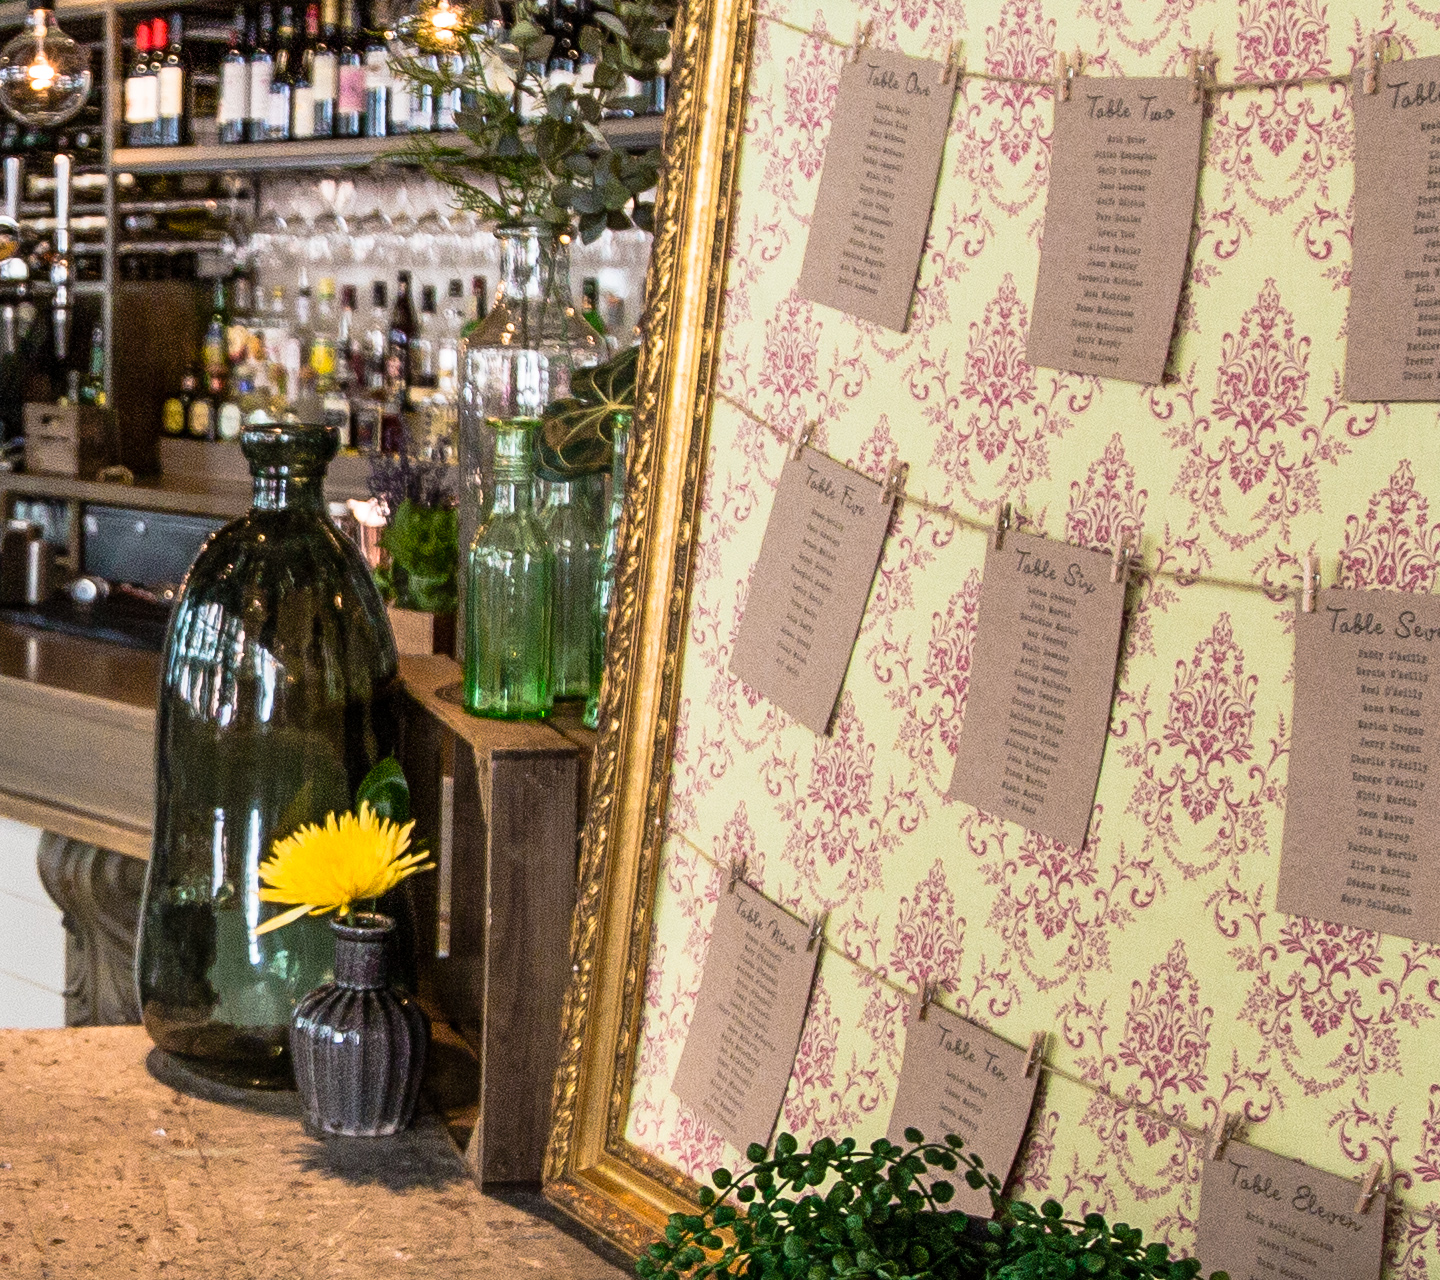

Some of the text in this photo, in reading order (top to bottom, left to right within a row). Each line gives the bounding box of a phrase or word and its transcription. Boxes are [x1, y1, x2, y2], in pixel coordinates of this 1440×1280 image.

[866, 63, 931, 96] Table One
[1086, 94, 1175, 121] Table Two
[806, 464, 865, 516] Table Five
[1016, 548, 1097, 595] Table Six
[1326, 606, 1384, 635] Table
[736, 893, 796, 954] Table Nine
[938, 1024, 1008, 1081] Table Ten
[1228, 1159, 1363, 1232] Table Eleven
